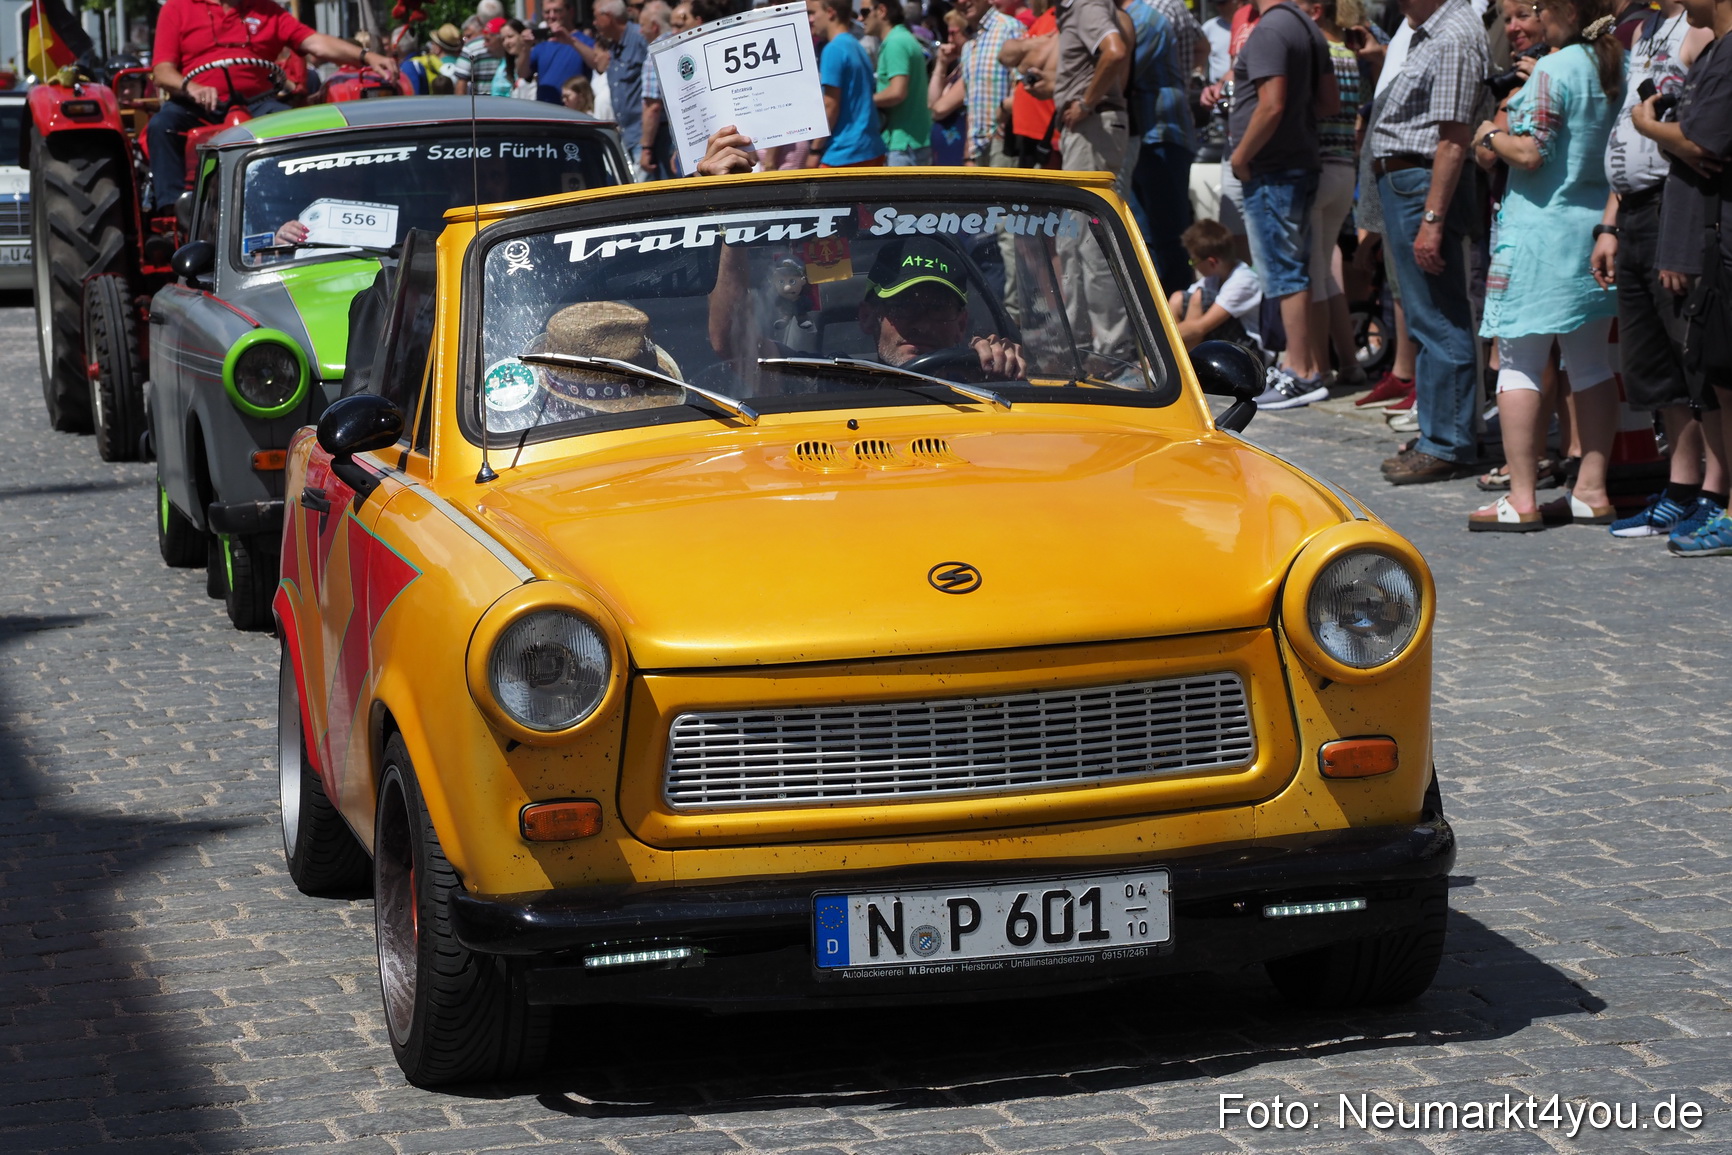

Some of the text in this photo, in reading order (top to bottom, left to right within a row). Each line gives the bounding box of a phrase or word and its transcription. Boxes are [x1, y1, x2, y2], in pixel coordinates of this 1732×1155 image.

[724, 37, 781, 74] 554
[278, 142, 558, 176] Trabant Szene Fürth
[341, 212, 376, 226] 556
[553, 207, 851, 263] Trabant
[901, 254, 949, 273] Atz'n
[1125, 883, 1147, 898] 04
[867, 900, 905, 957] N
[946, 897, 982, 952] P
[1005, 886, 1110, 947] 601
[1126, 920, 1149, 937] 10
[826, 938, 839, 954] D
[908, 964, 954, 976] M.Brendel
[960, 960, 1004, 973] Hersbruck
[1010, 953, 1095, 970] Unfallinstandsetzung
[1101, 947, 1150, 961] 09151/2461
